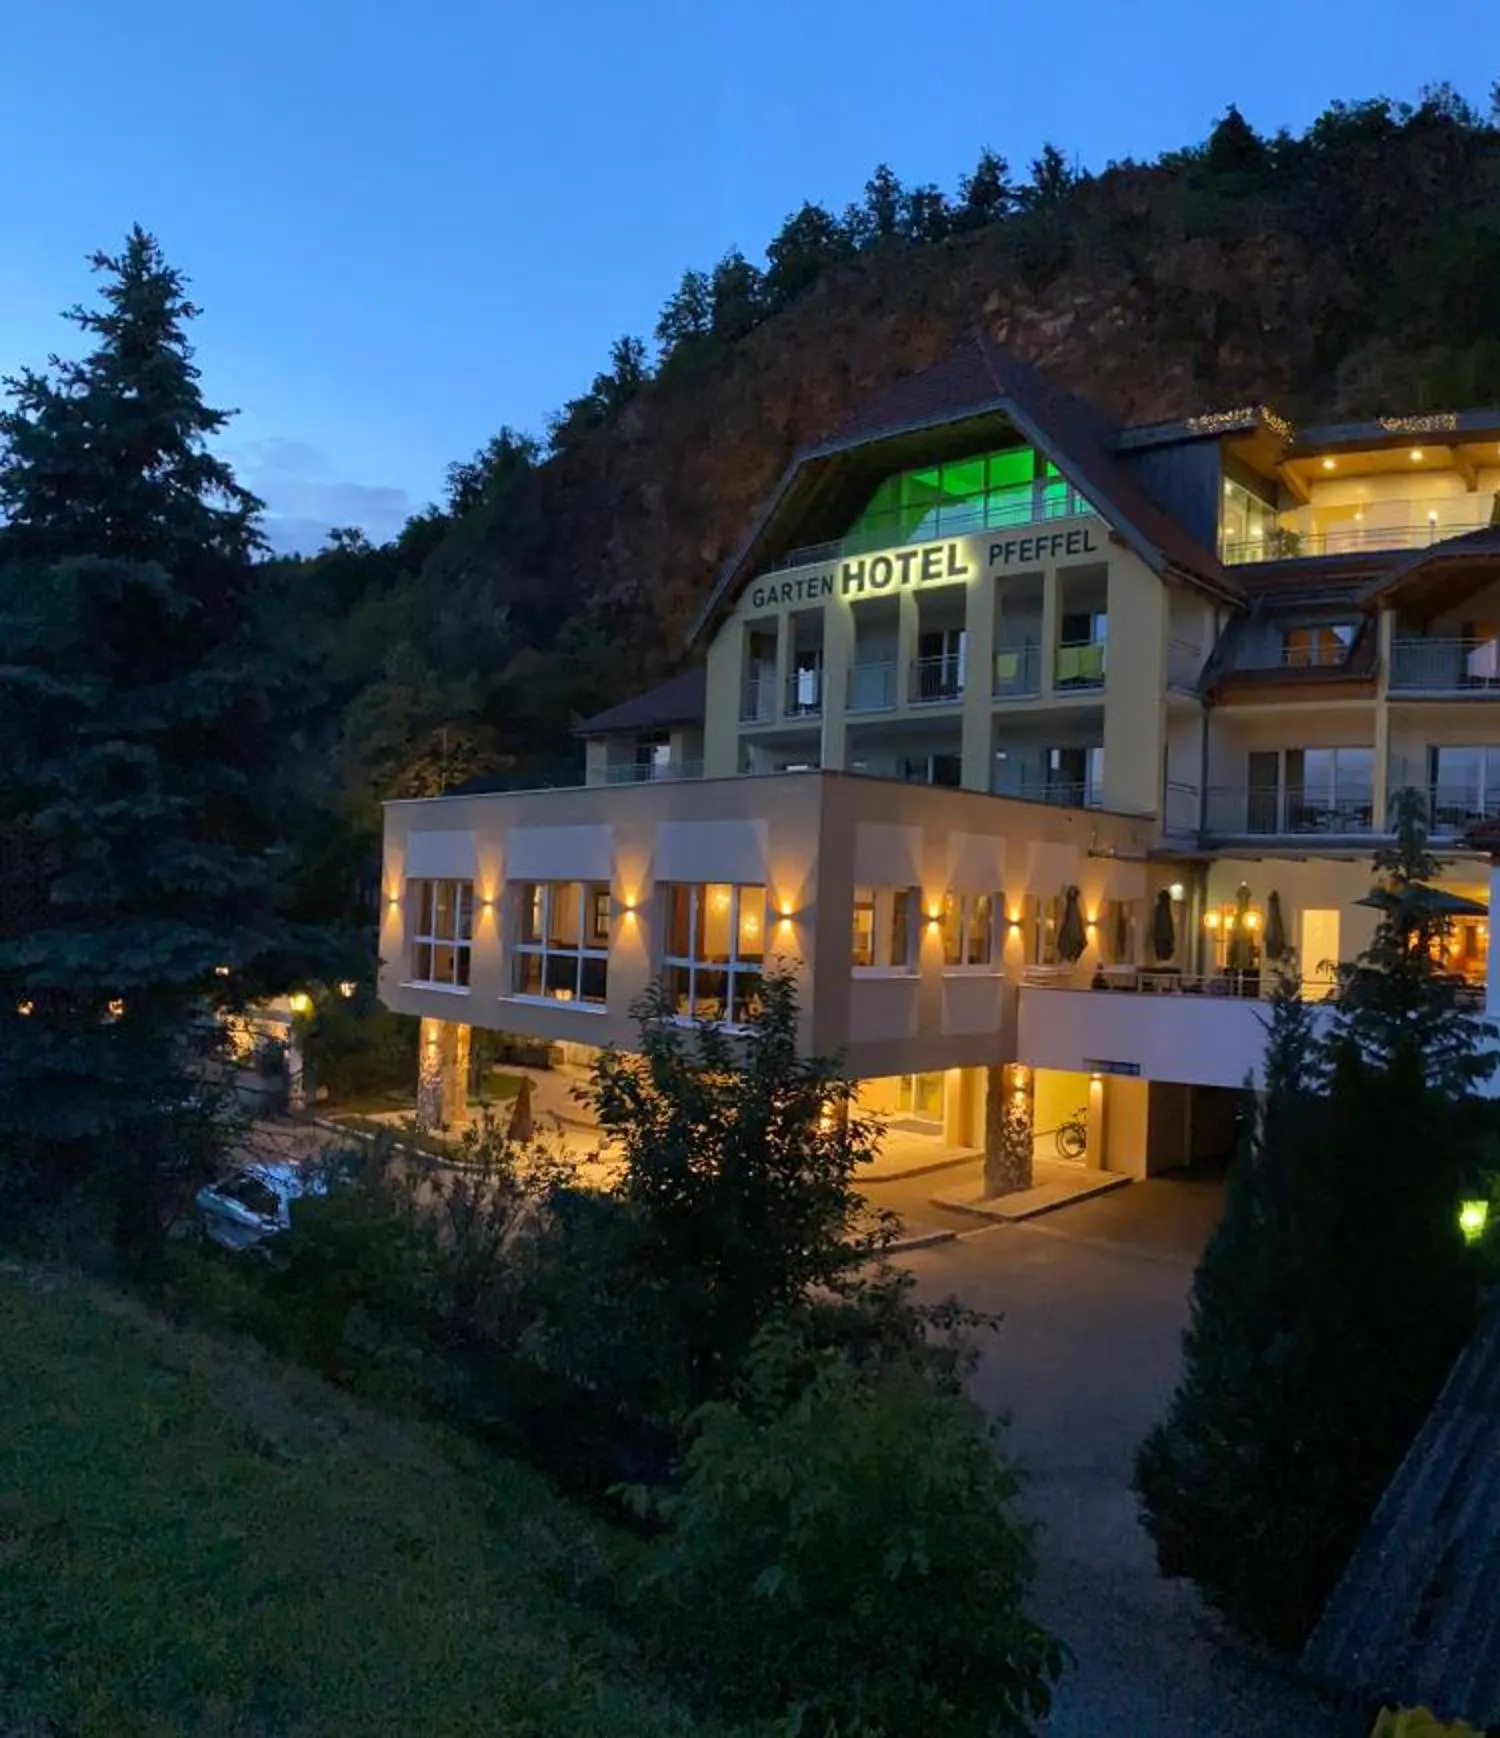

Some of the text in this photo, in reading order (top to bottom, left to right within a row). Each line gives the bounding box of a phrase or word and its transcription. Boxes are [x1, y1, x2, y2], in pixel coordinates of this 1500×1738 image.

[753, 529, 1097, 608] GARTEN HOTEL PFEFFEL
